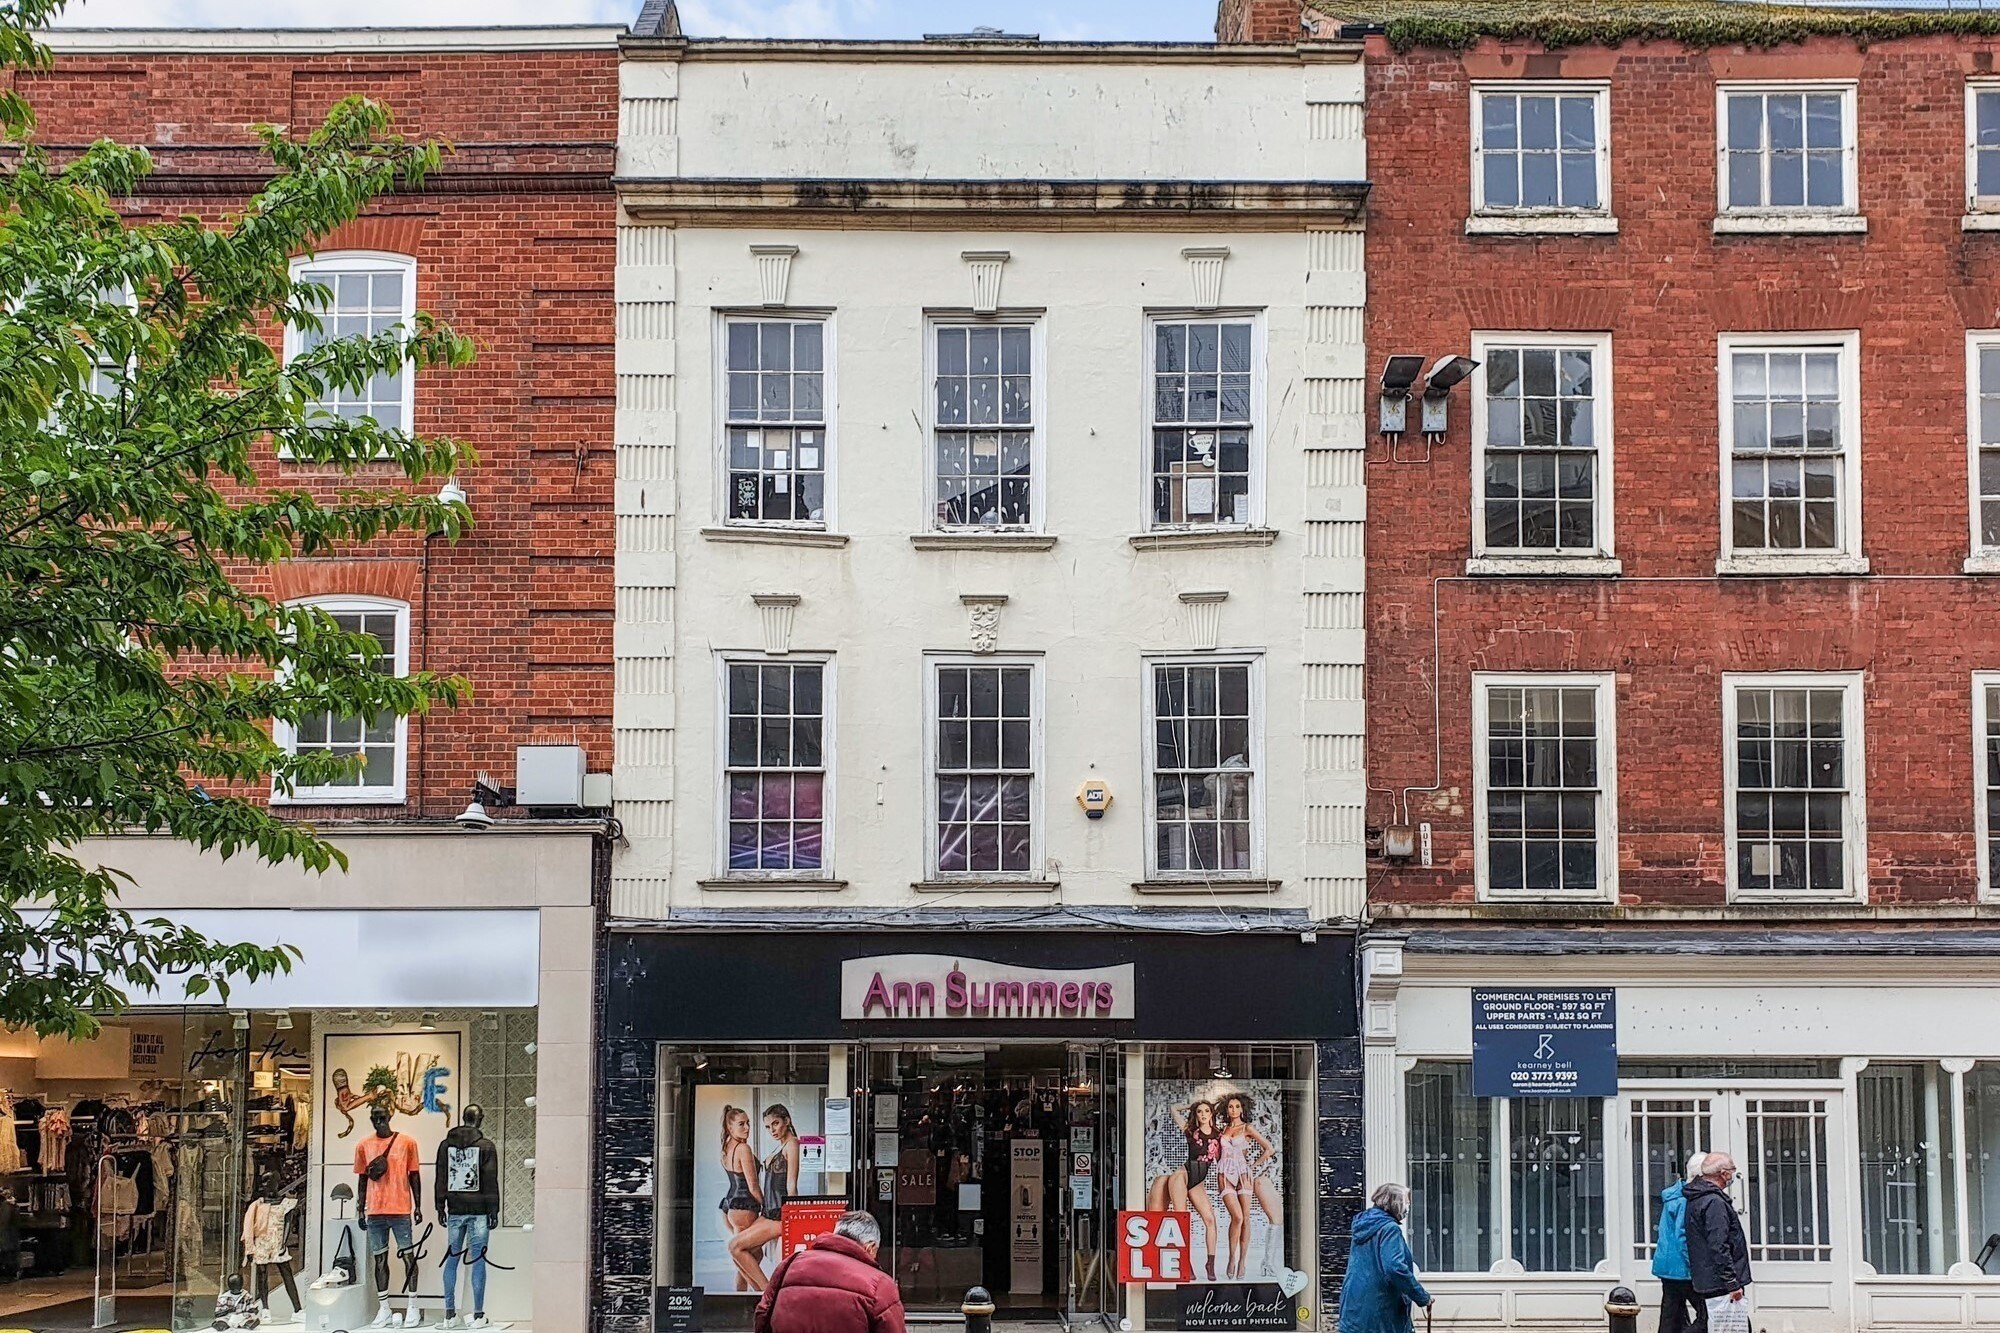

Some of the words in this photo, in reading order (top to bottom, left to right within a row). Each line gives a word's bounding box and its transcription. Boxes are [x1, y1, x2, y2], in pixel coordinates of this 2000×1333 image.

[1087, 791, 1103, 800] ADT
[862, 971, 935, 1011] Ann
[945, 970, 1114, 1011] Summers
[1475, 993, 1535, 1001] COMMERCIAL
[1537, 993, 1580, 1001] PREMISES
[1581, 993, 1594, 1001] TO
[1486, 1012, 1515, 1020] UPPER
[1517, 1012, 1546, 1020] PARTS
[1553, 1012, 1575, 1021] 1,832
[1577, 1012, 1590, 1020] SQ
[1591, 1012, 1603, 1020] FT
[256, 1033, 307, 1063] the
[1518, 1061, 1552, 1069] kearney
[1511, 1072, 1529, 1080] 020
[1531, 1072, 1553, 1080] 3773
[1555, 1072, 1578, 1080] 9393
[1014, 1148, 1040, 1157] STOP
[901, 1174, 932, 1186] SALE
[668, 1296, 693, 1306] 20%
[1186, 1289, 1242, 1319] welcome
[1245, 1288, 1287, 1318] back
[1250, 1317, 1288, 1325] PHYSICAL
